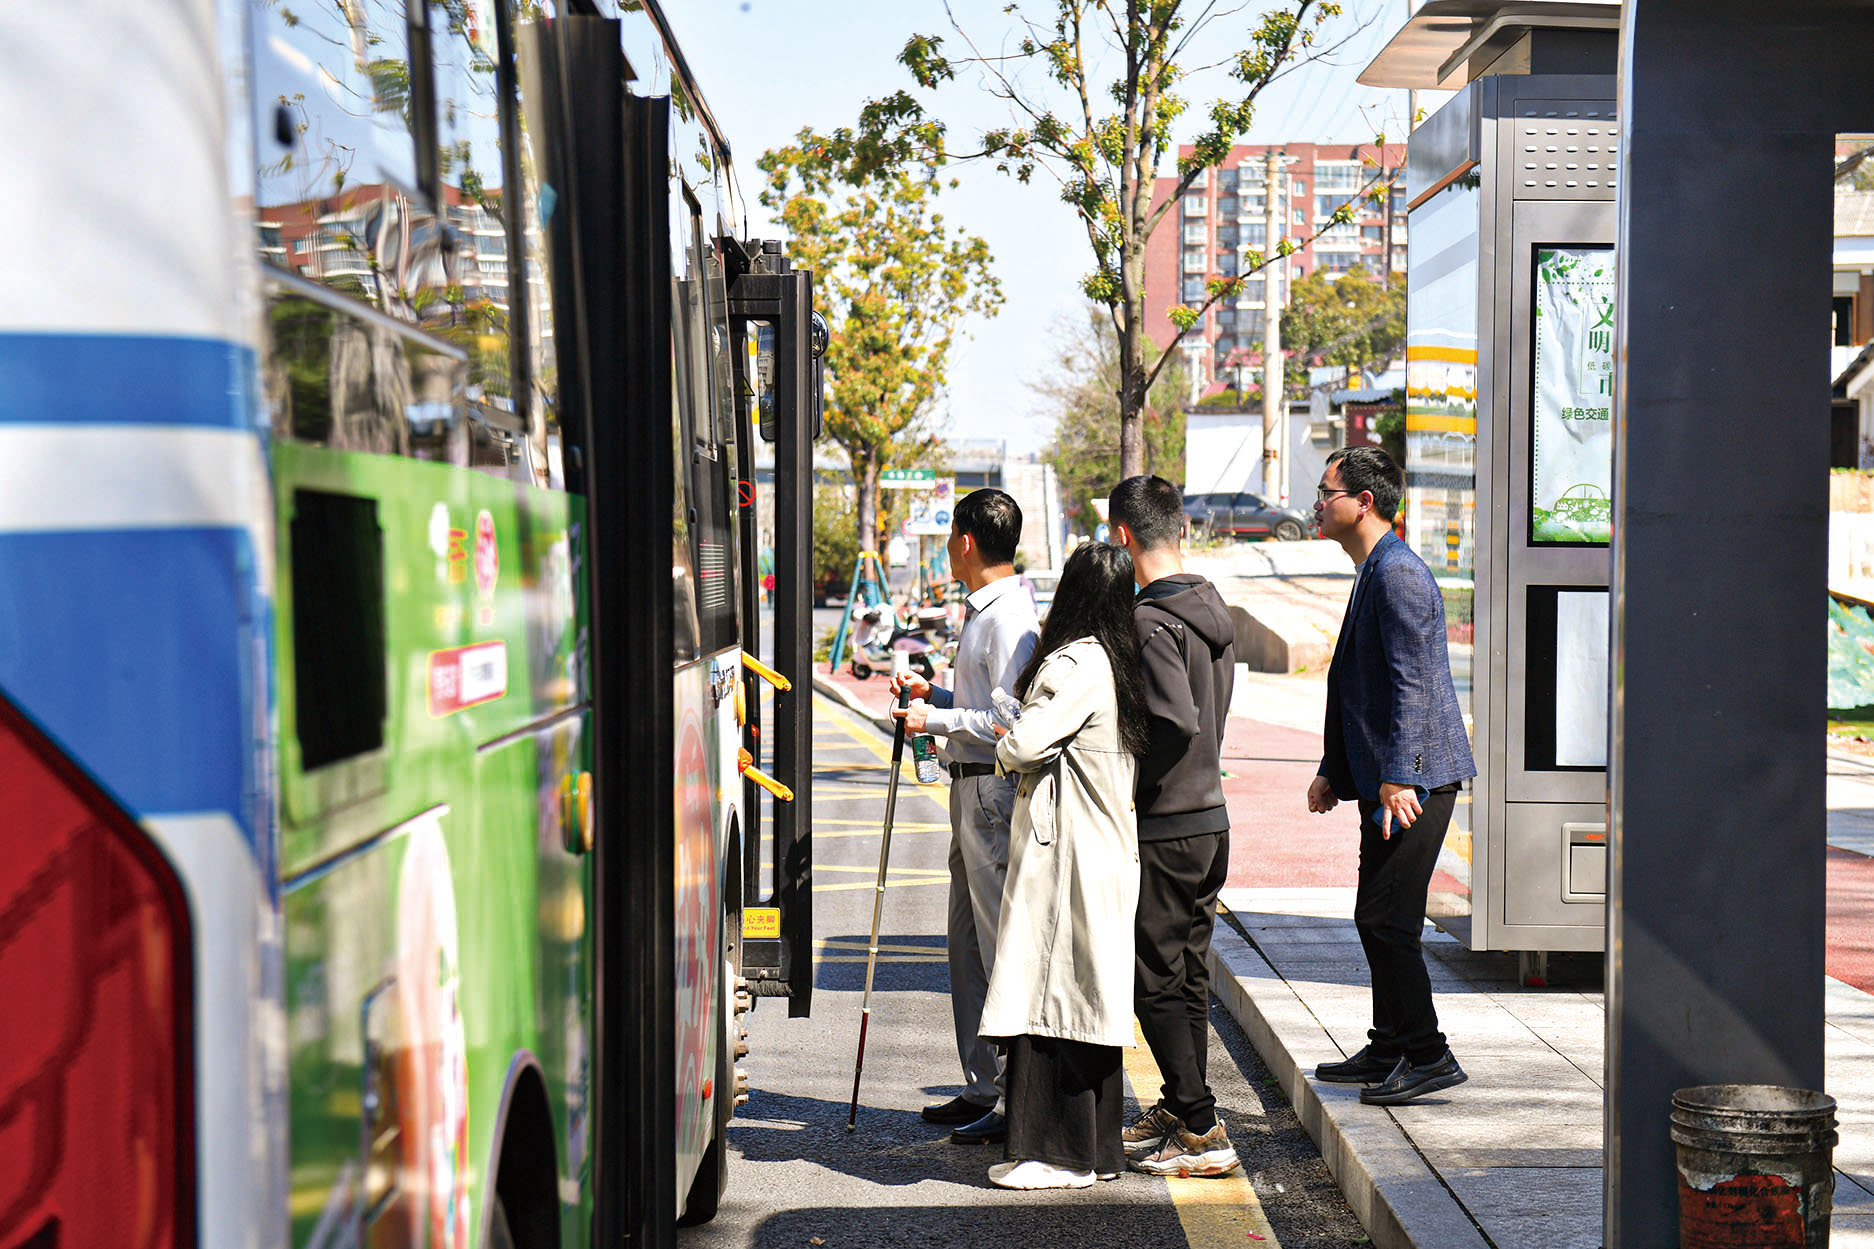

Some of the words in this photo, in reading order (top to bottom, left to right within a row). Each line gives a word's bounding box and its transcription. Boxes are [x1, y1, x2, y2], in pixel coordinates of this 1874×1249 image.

[1561, 407, 1608, 420] 绿色交通
[742, 914, 776, 924] 心夹脚
